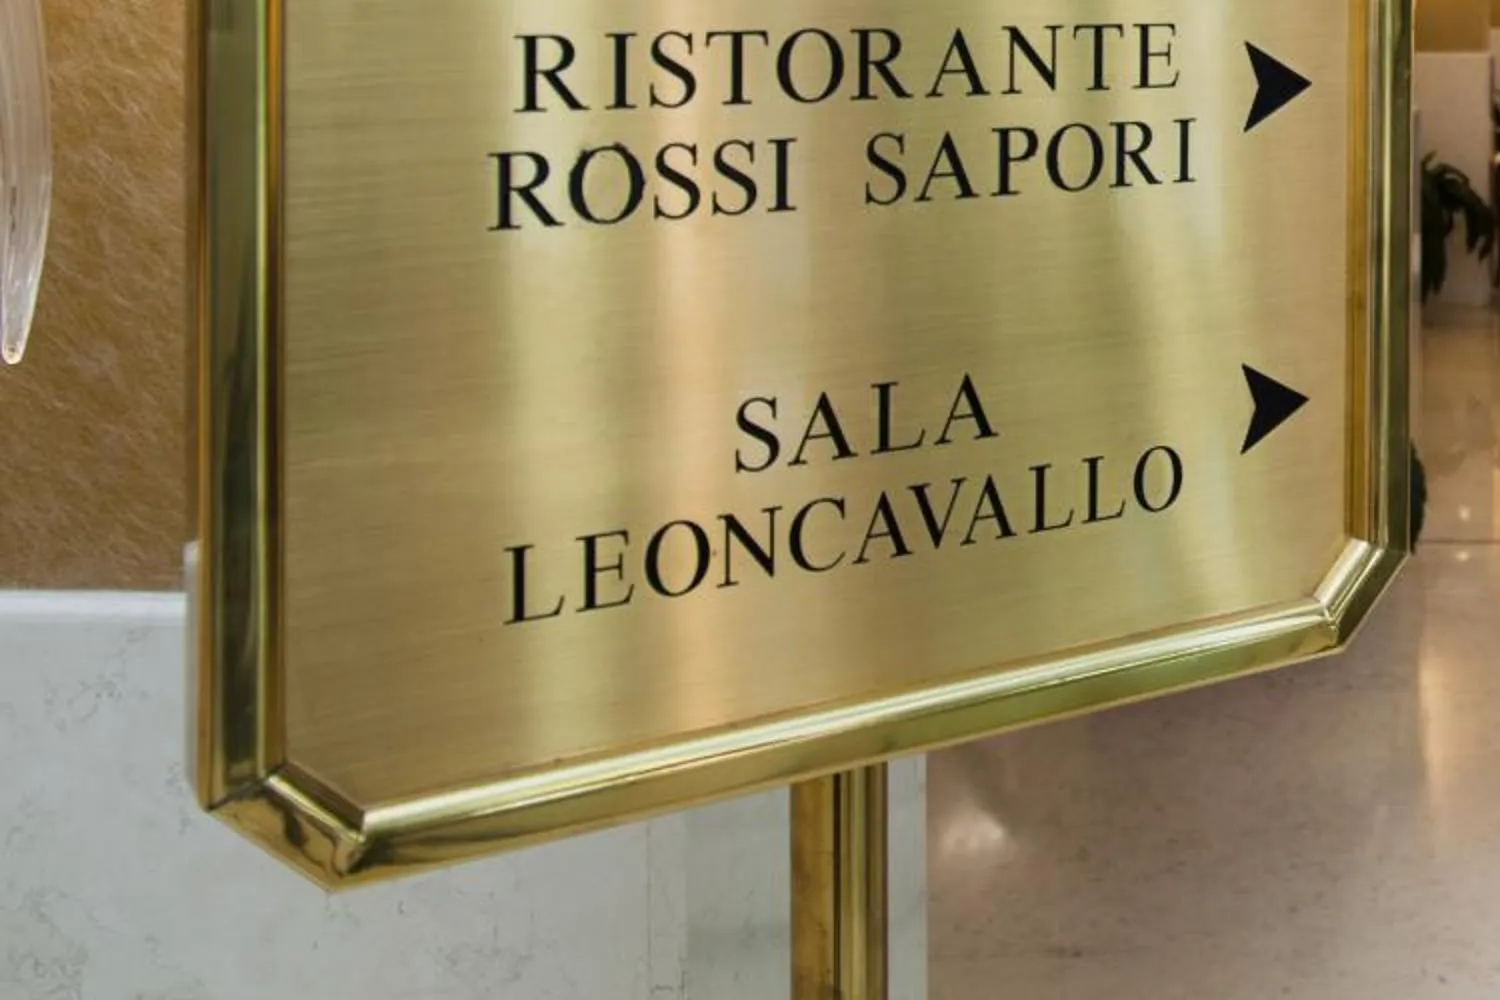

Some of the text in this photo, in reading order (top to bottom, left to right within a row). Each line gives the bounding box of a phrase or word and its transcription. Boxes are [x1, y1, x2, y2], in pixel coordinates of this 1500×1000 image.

[513, 22, 1181, 114] RISTORANTE
[488, 117, 1198, 232] ROSSI SAPORI
[734, 372, 999, 475] SALA
[503, 444, 1185, 626] LEONCAVALLO
